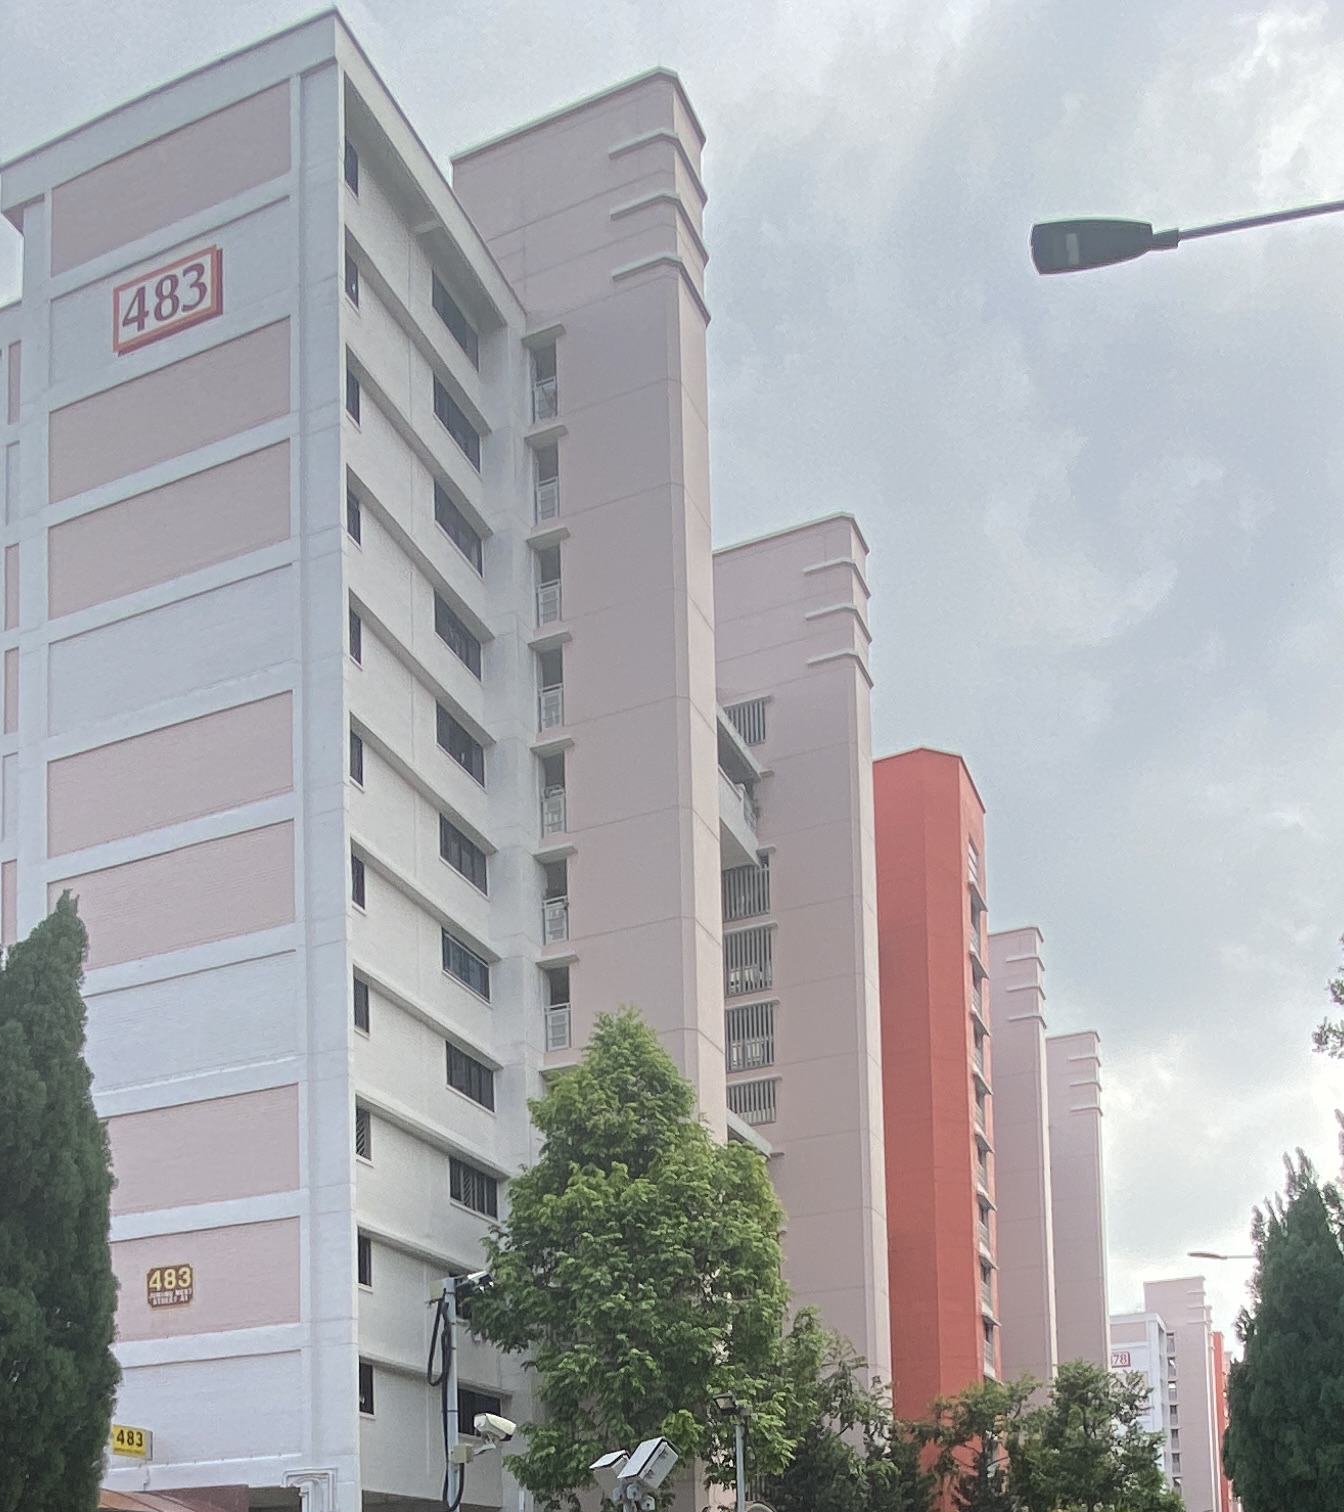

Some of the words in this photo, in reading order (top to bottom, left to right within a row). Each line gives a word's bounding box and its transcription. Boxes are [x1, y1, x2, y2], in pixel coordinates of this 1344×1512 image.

[122, 263, 208, 331] 483
[149, 1267, 192, 1291] 483
[116, 1429, 144, 1448] 483
